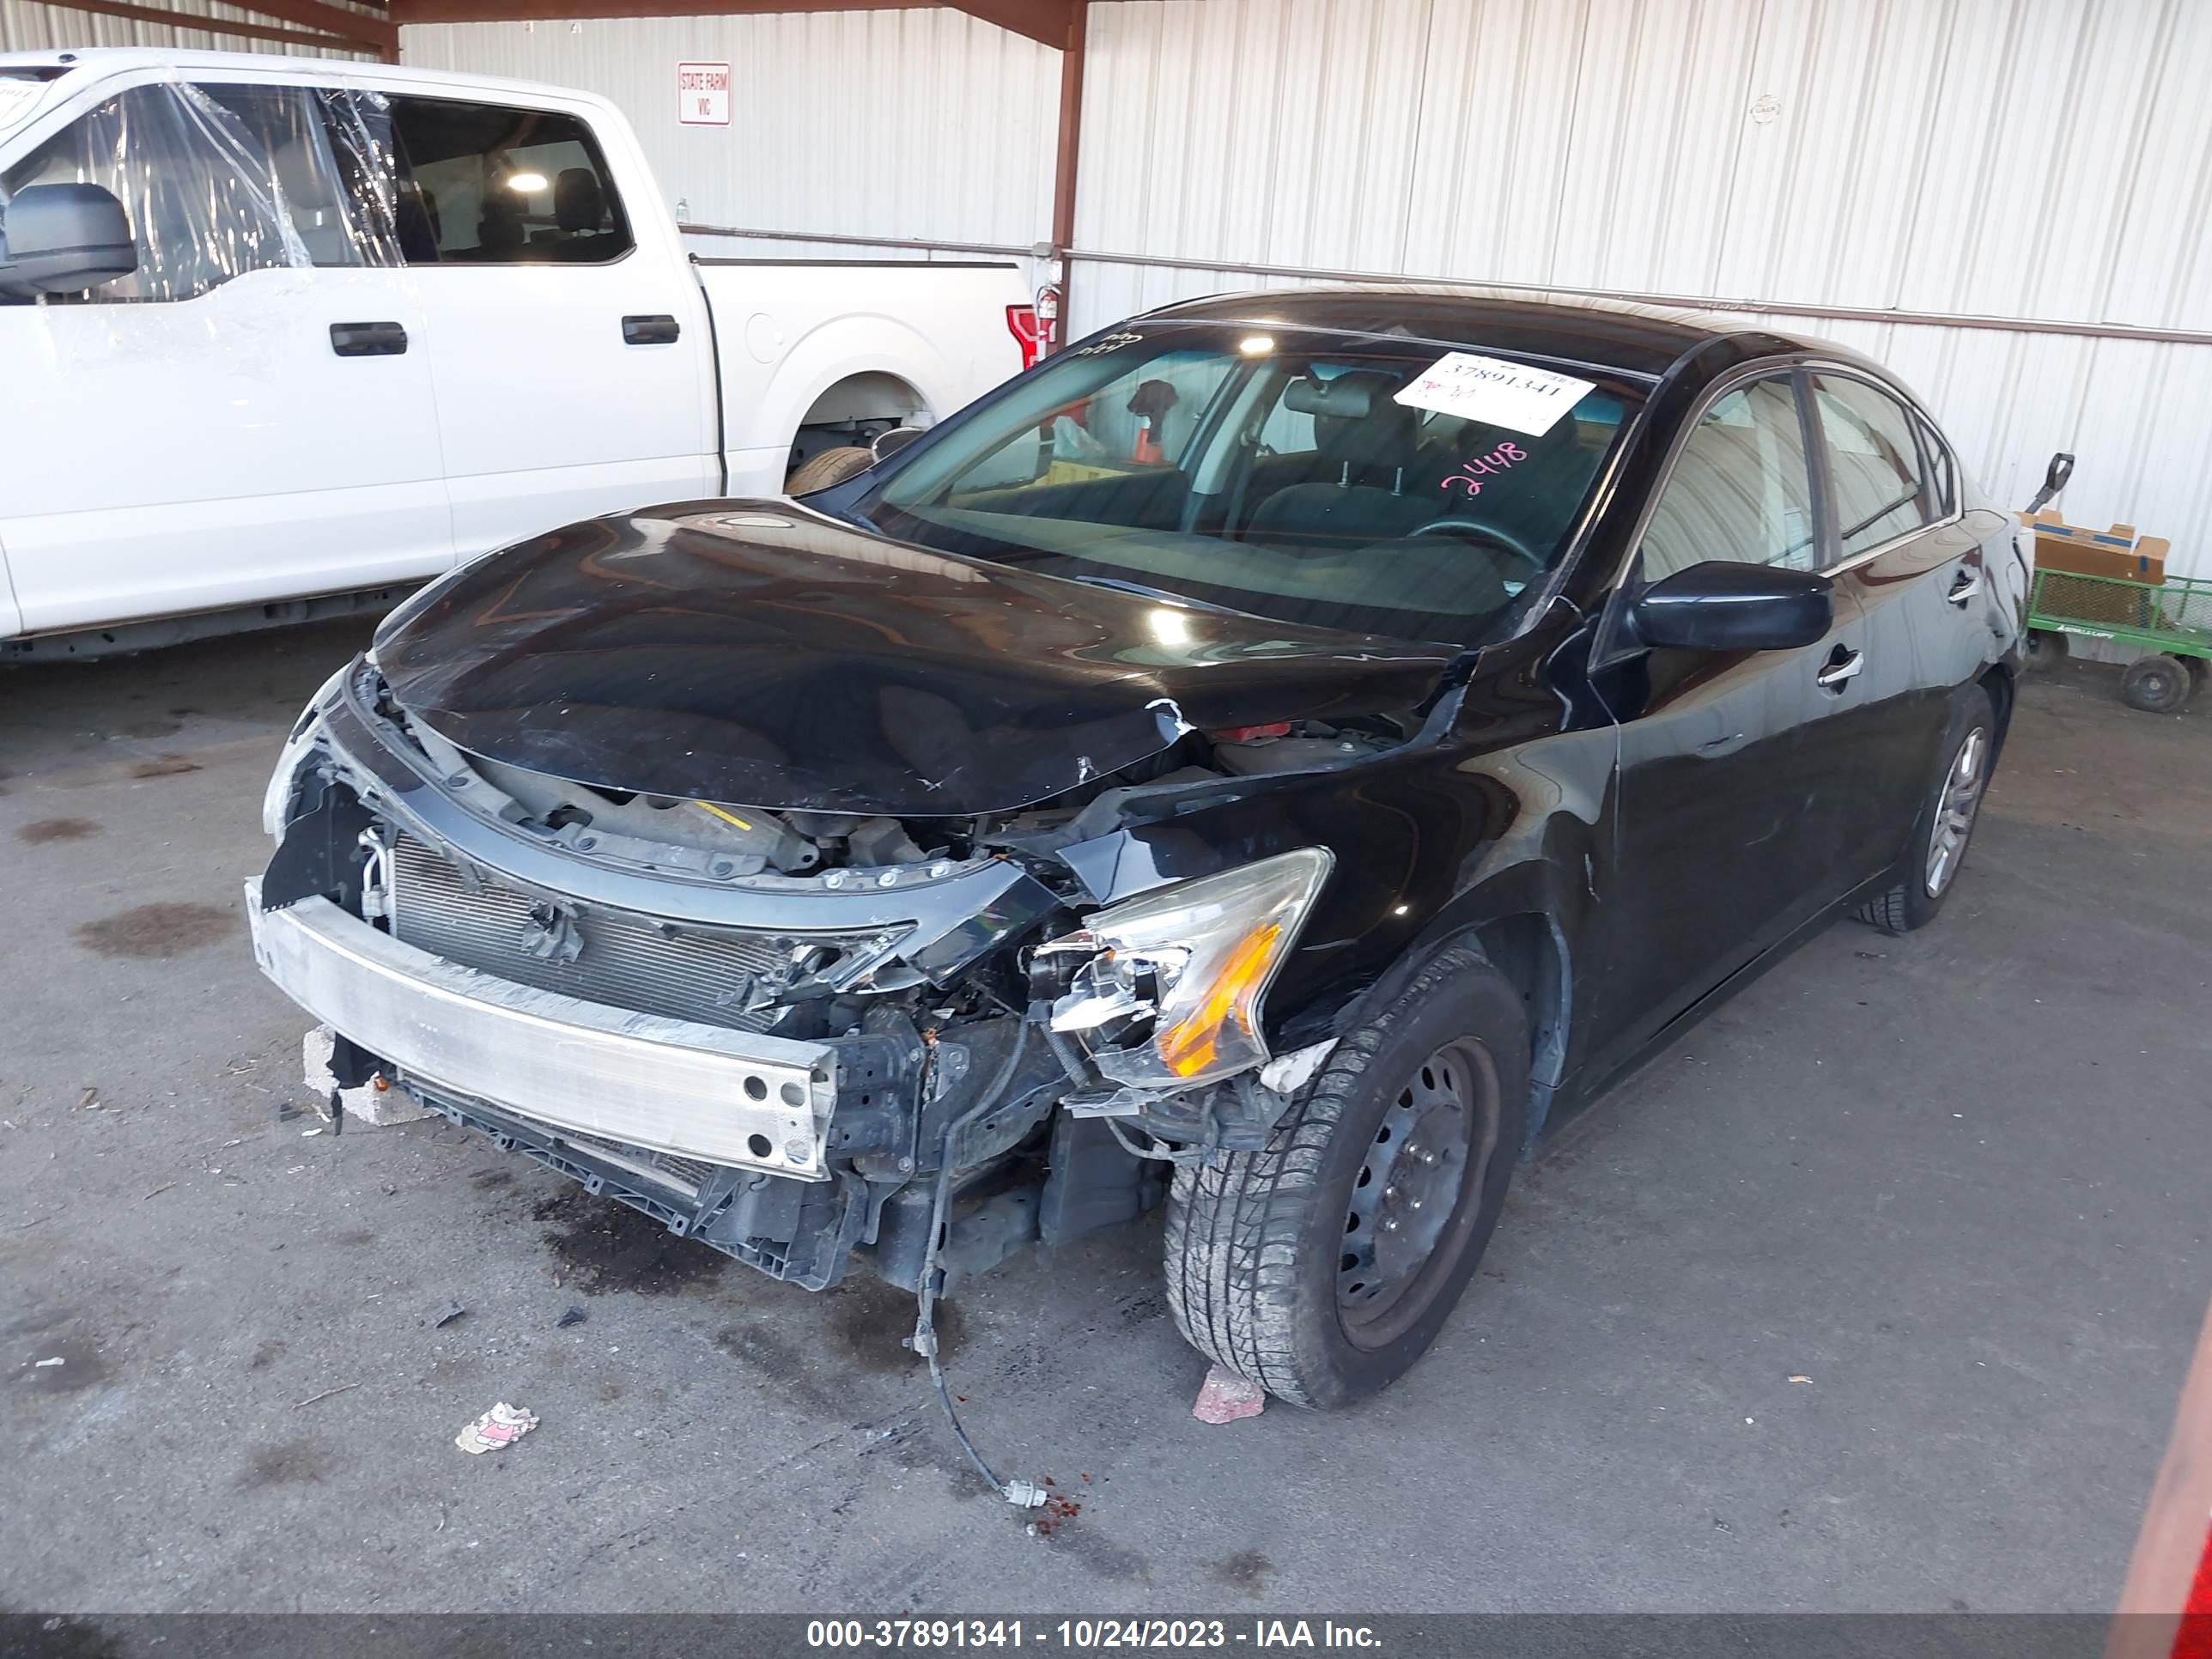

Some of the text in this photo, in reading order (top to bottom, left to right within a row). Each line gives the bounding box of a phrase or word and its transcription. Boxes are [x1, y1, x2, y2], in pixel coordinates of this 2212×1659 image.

[682, 72, 728, 91] STATE FARM
[1445, 363, 1562, 398] 37891341
[1440, 441, 1528, 496] 2448
